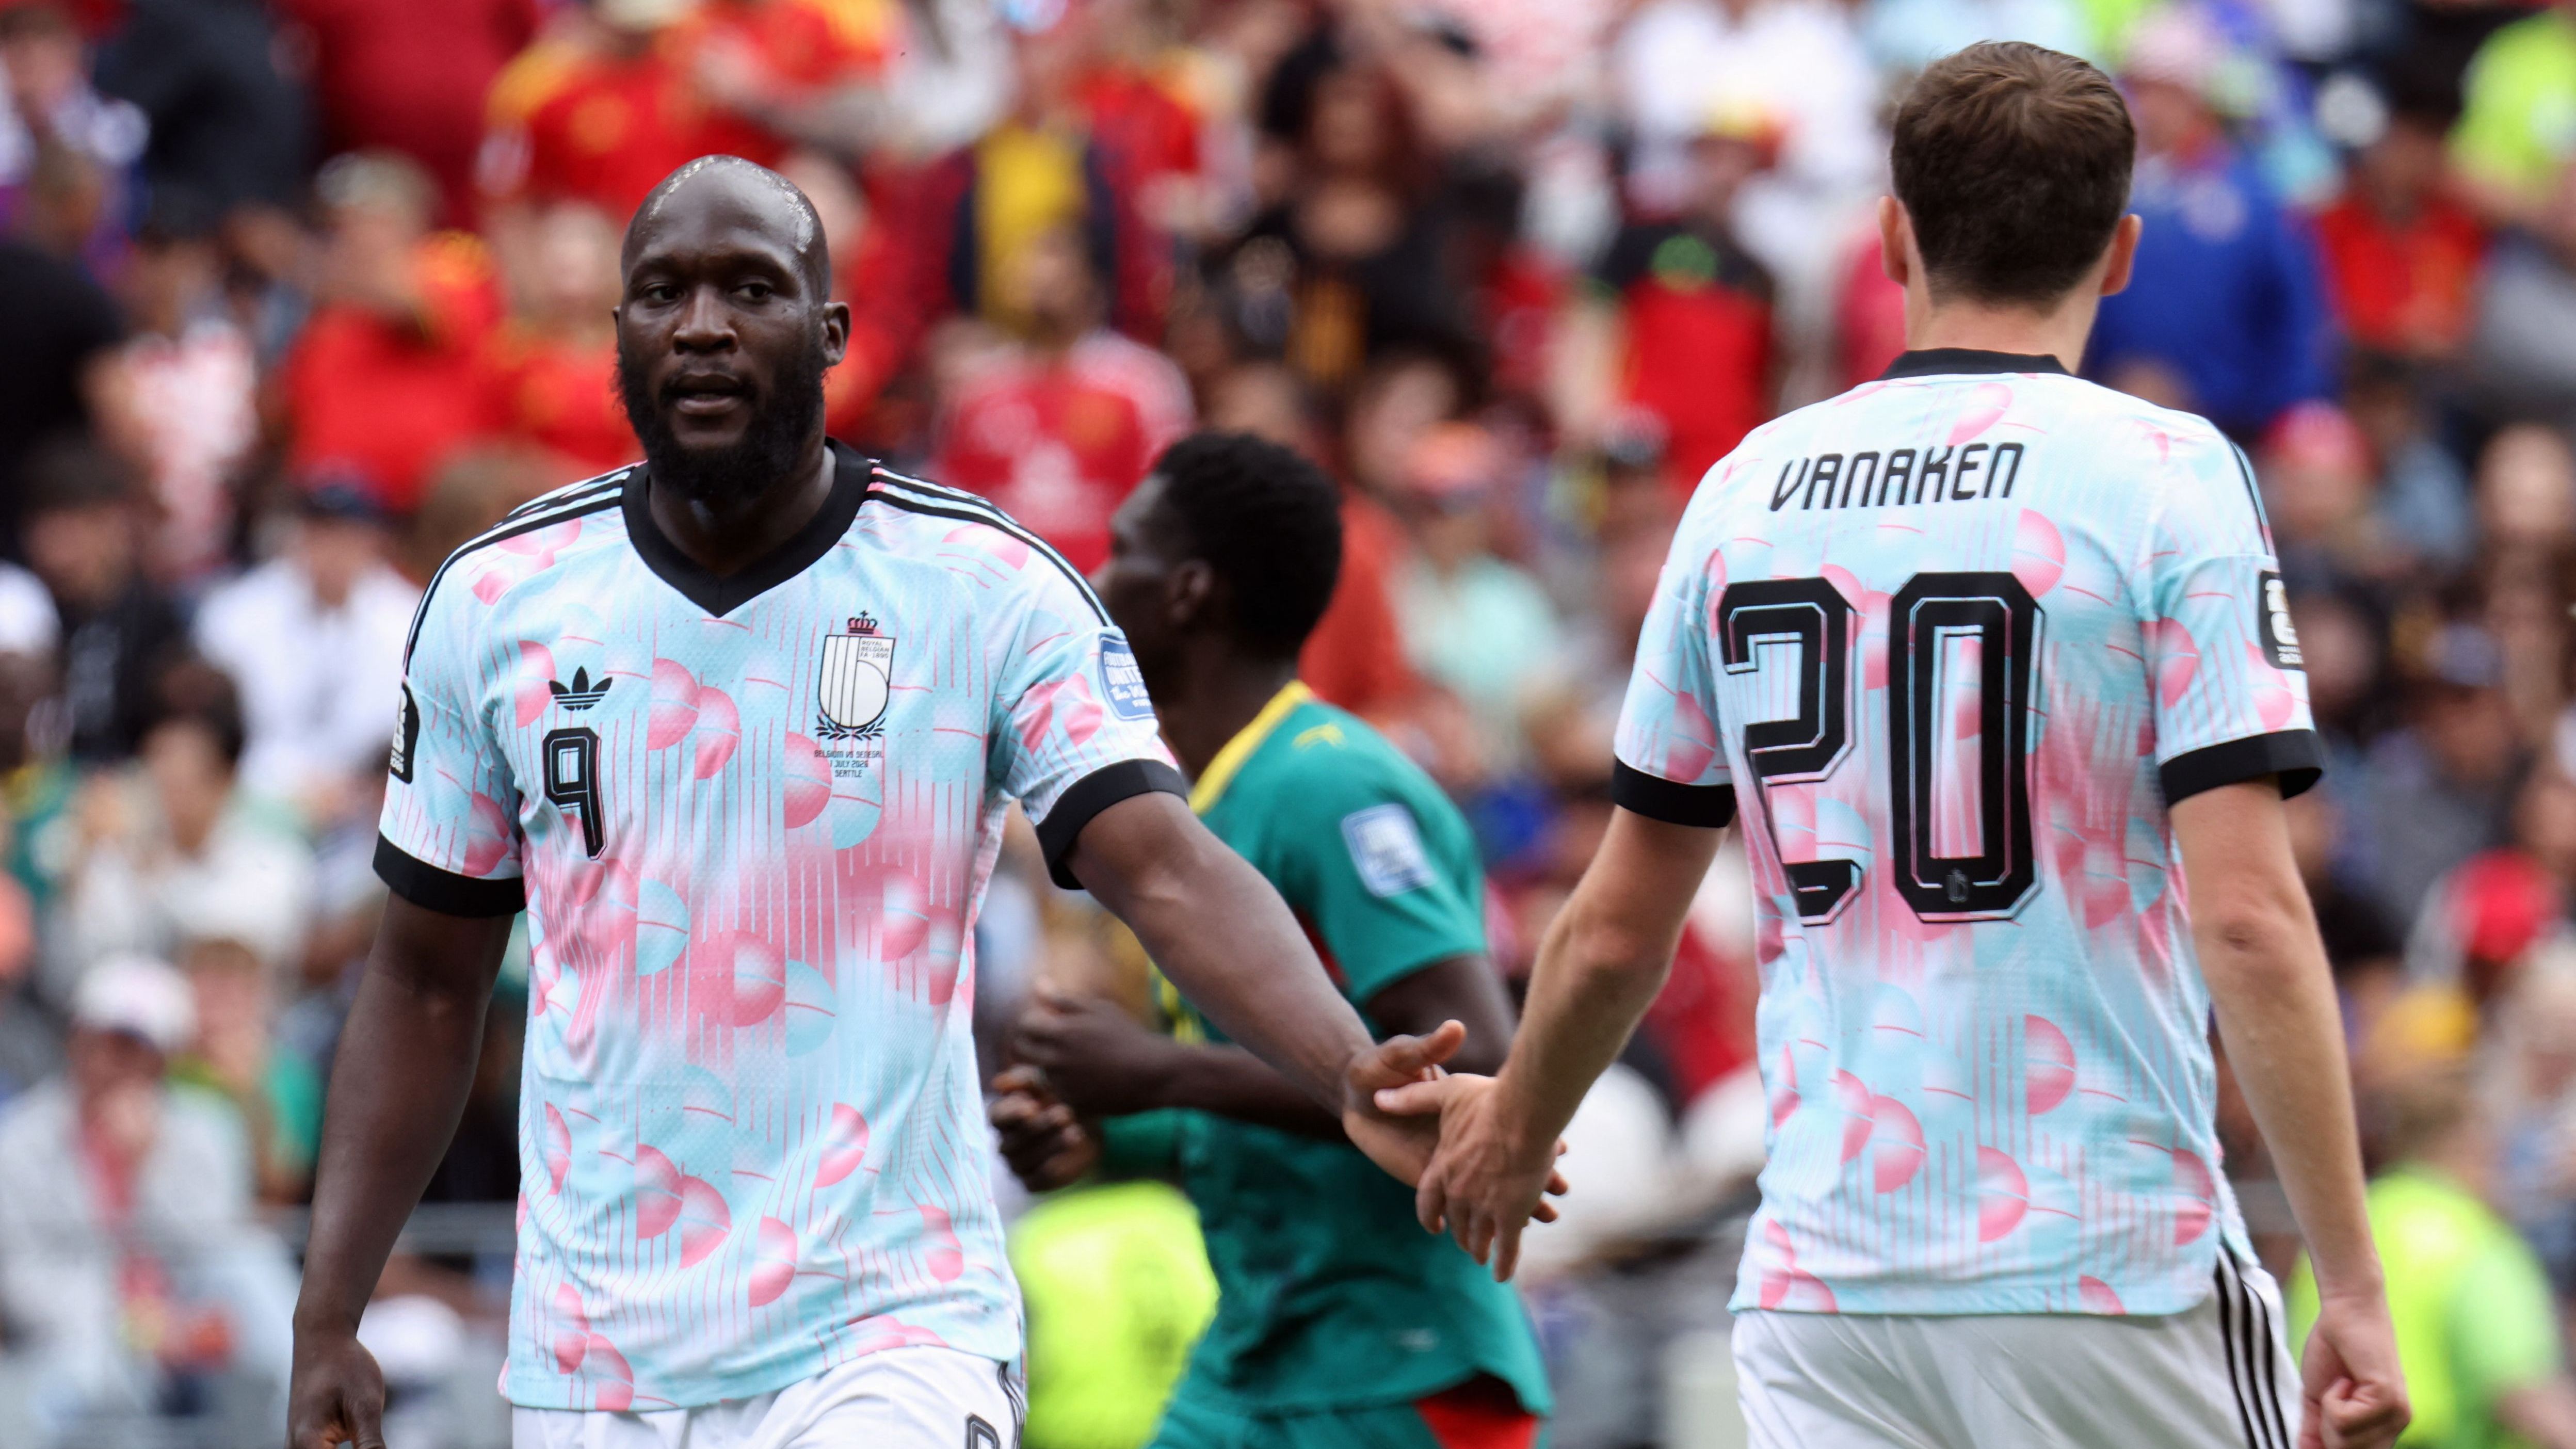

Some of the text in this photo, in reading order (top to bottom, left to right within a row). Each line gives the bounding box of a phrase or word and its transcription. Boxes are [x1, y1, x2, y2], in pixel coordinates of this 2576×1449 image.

[1769, 442, 2024, 511] VANAKEN
[814, 749, 844, 758] BELGIUM
[834, 760, 850, 768] JULY
[851, 760, 868, 768] 2026
[1718, 572, 2044, 926] 20
[834, 769, 863, 778] SEATTLE
[542, 727, 607, 860] 9
